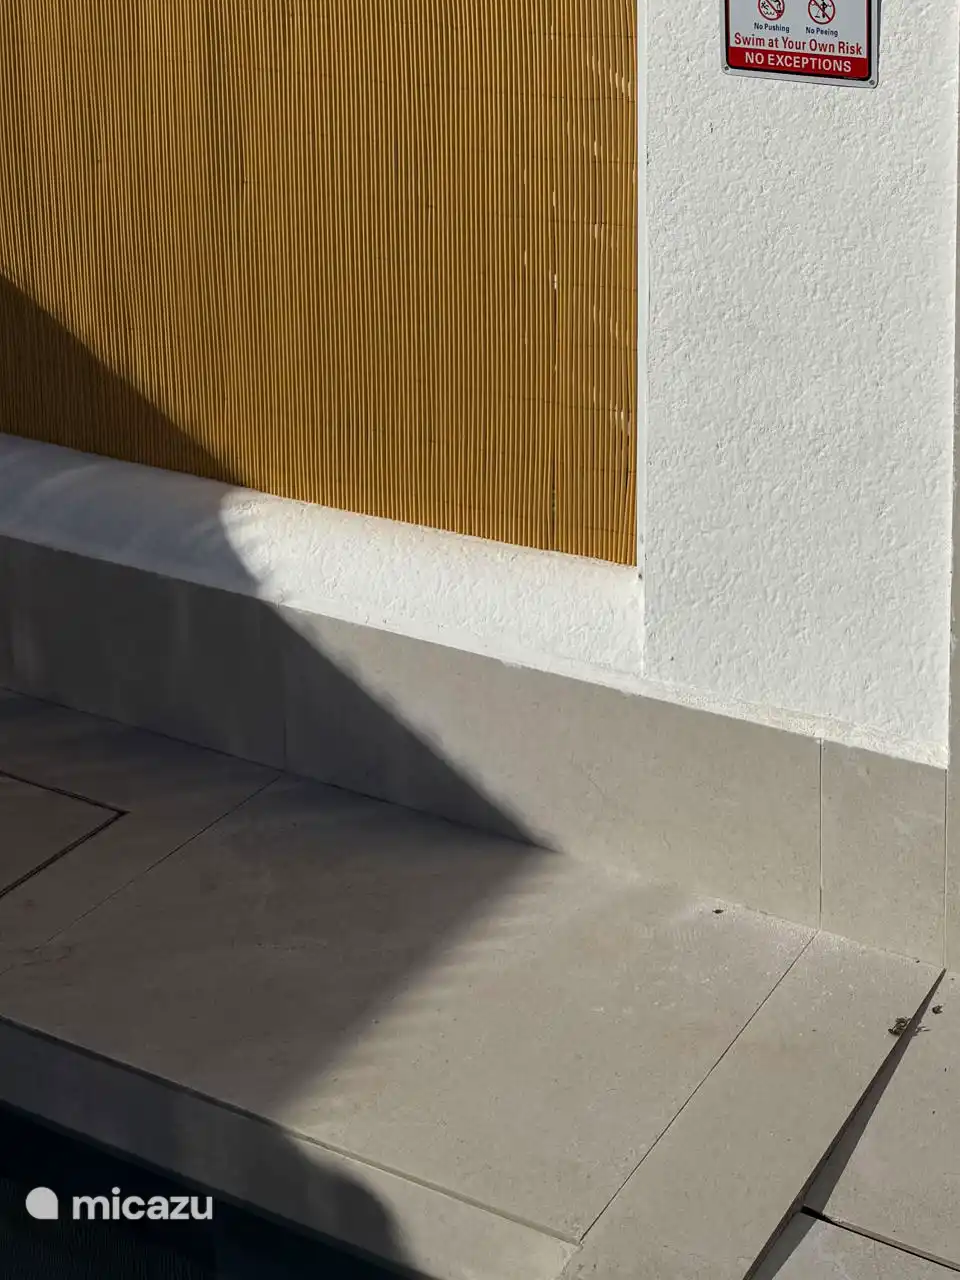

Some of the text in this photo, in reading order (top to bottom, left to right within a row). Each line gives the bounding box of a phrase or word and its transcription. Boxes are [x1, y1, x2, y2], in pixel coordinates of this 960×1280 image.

[754, 22, 790, 34] No Pushing
[805, 27, 839, 38] No Peeing
[734, 32, 863, 55] Swim at Your Own Risk
[745, 51, 852, 73] NO EXCEPTIONS
